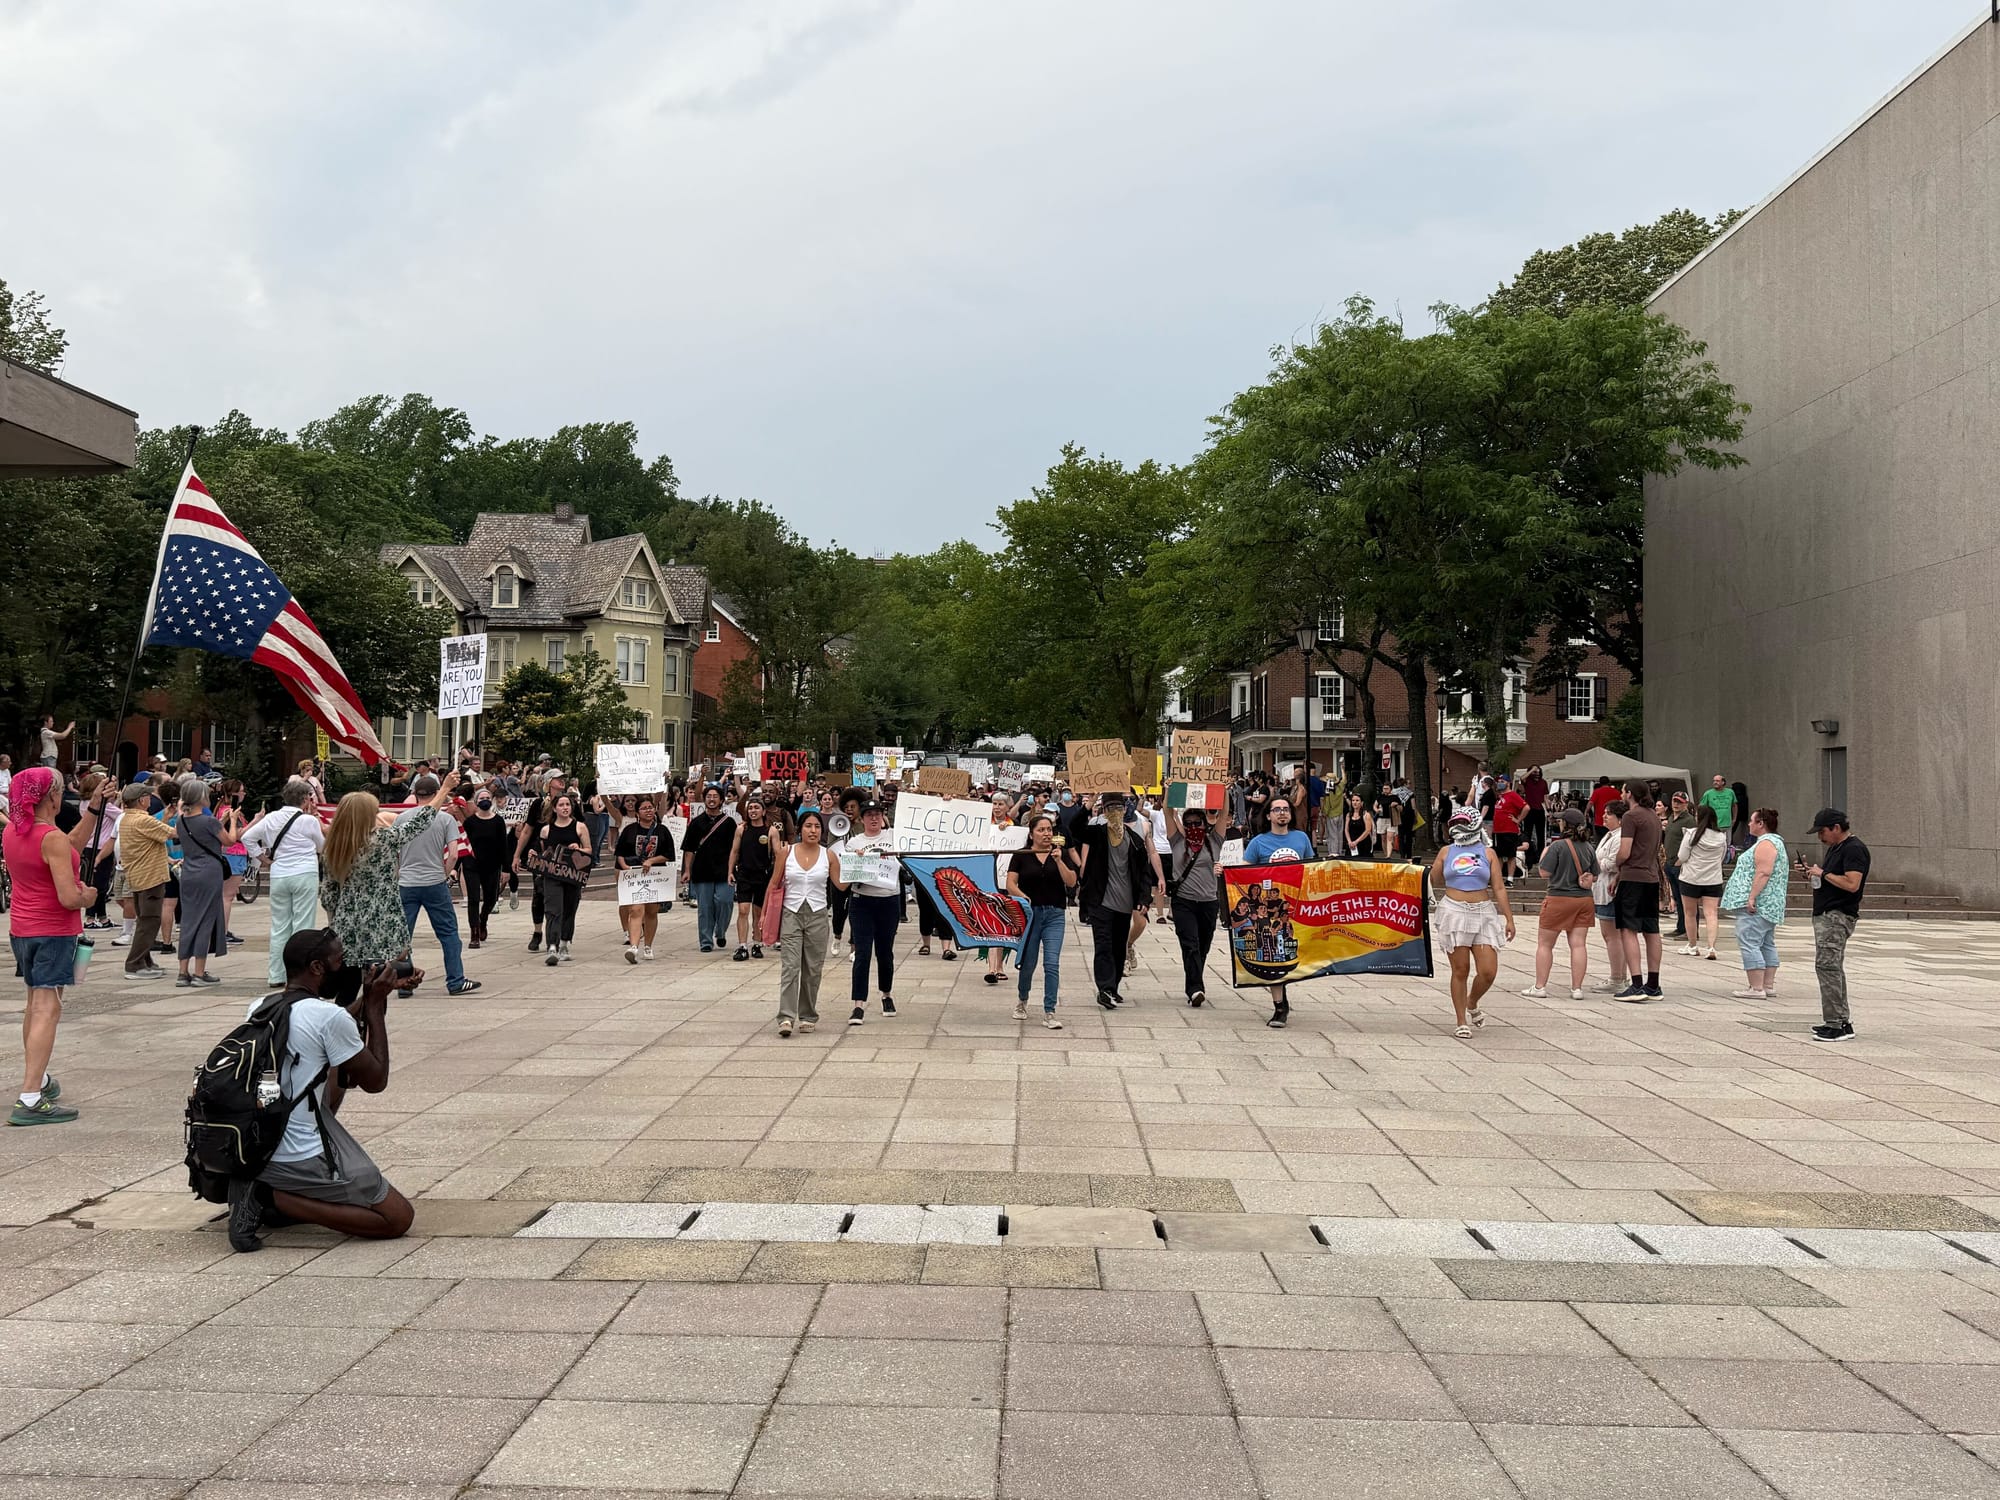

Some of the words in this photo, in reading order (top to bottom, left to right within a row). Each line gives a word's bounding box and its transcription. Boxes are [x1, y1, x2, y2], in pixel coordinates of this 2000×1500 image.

[442, 670, 460, 684] ARE
[465, 668, 483, 681] YOU
[443, 685, 483, 707] NEXT?
[1178, 735, 1195, 744] WE
[1201, 736, 1227, 749] WILL
[601, 745, 620, 760] NO
[1074, 742, 1125, 761] CHINGA
[1178, 745, 1200, 755] NOT
[1207, 748, 1221, 757] BE
[766, 752, 807, 769] FUCK
[1006, 761, 1020, 771] END
[1071, 760, 1092, 774] LA
[1177, 756, 1228, 767] INTIMIDATED
[770, 769, 800, 780] ICE
[1073, 771, 1126, 791] MIGRA
[1171, 767, 1202, 781] FUCK
[1204, 769, 1227, 782] ICE
[903, 806, 950, 833] ICE
[953, 813, 987, 837] OUT
[899, 836, 917, 851] OF
[1299, 901, 1339, 917] MAKE
[1342, 896, 1374, 911] THE
[1379, 896, 1420, 917] ROAD
[1332, 909, 1416, 929] PENNSYLVANIA
